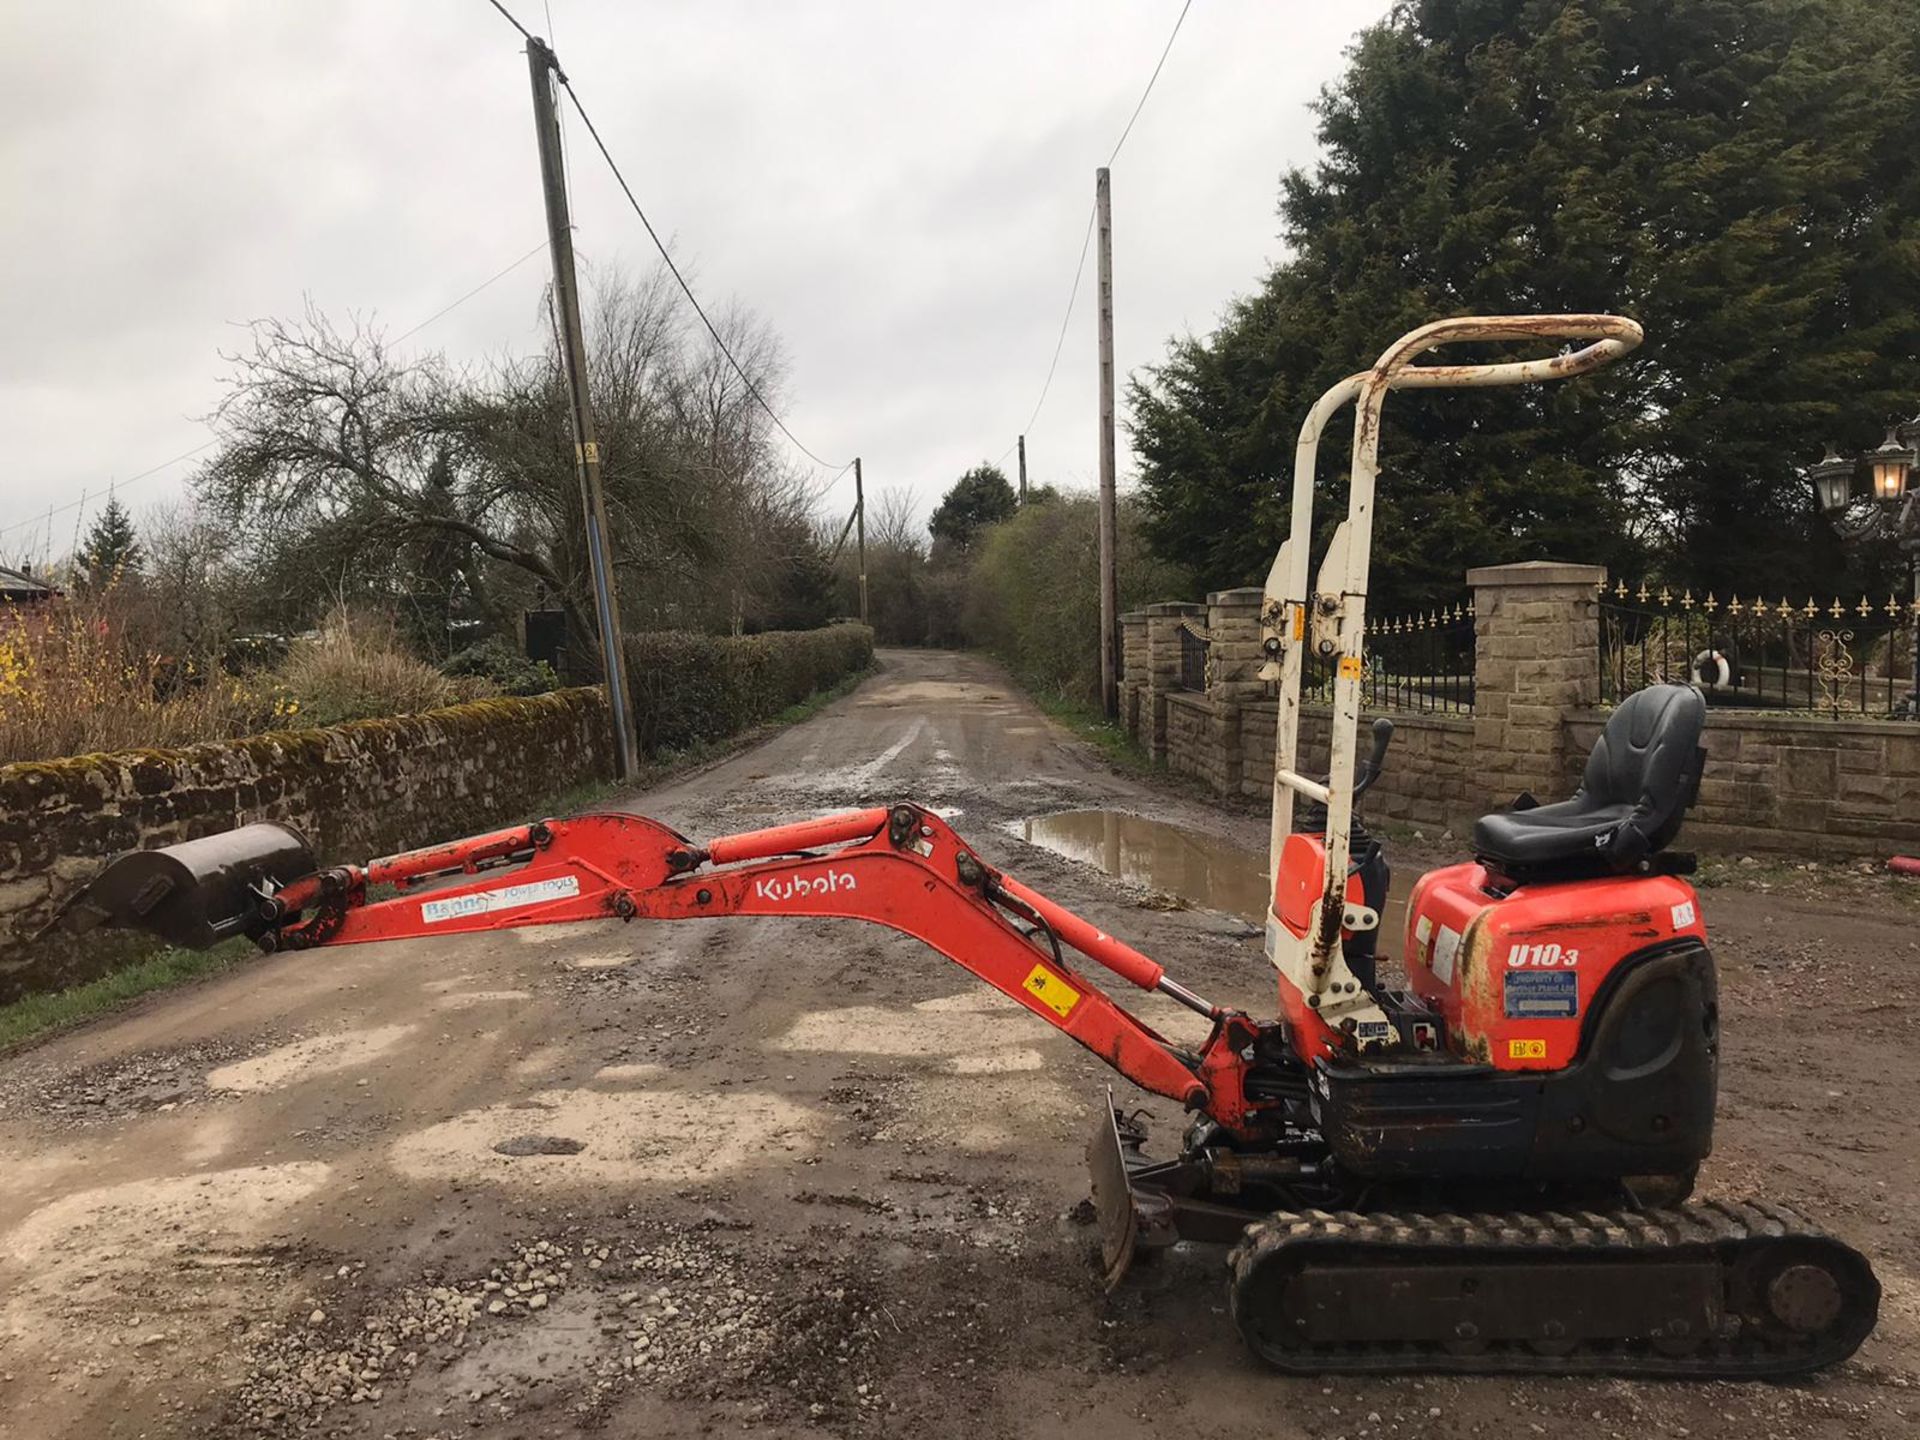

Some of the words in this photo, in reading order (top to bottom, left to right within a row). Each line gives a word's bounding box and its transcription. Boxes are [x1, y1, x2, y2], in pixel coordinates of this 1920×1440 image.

[542, 877, 574, 890] TOOLS
[756, 869, 856, 902] Kubota
[1507, 943, 1579, 967] U10-3
